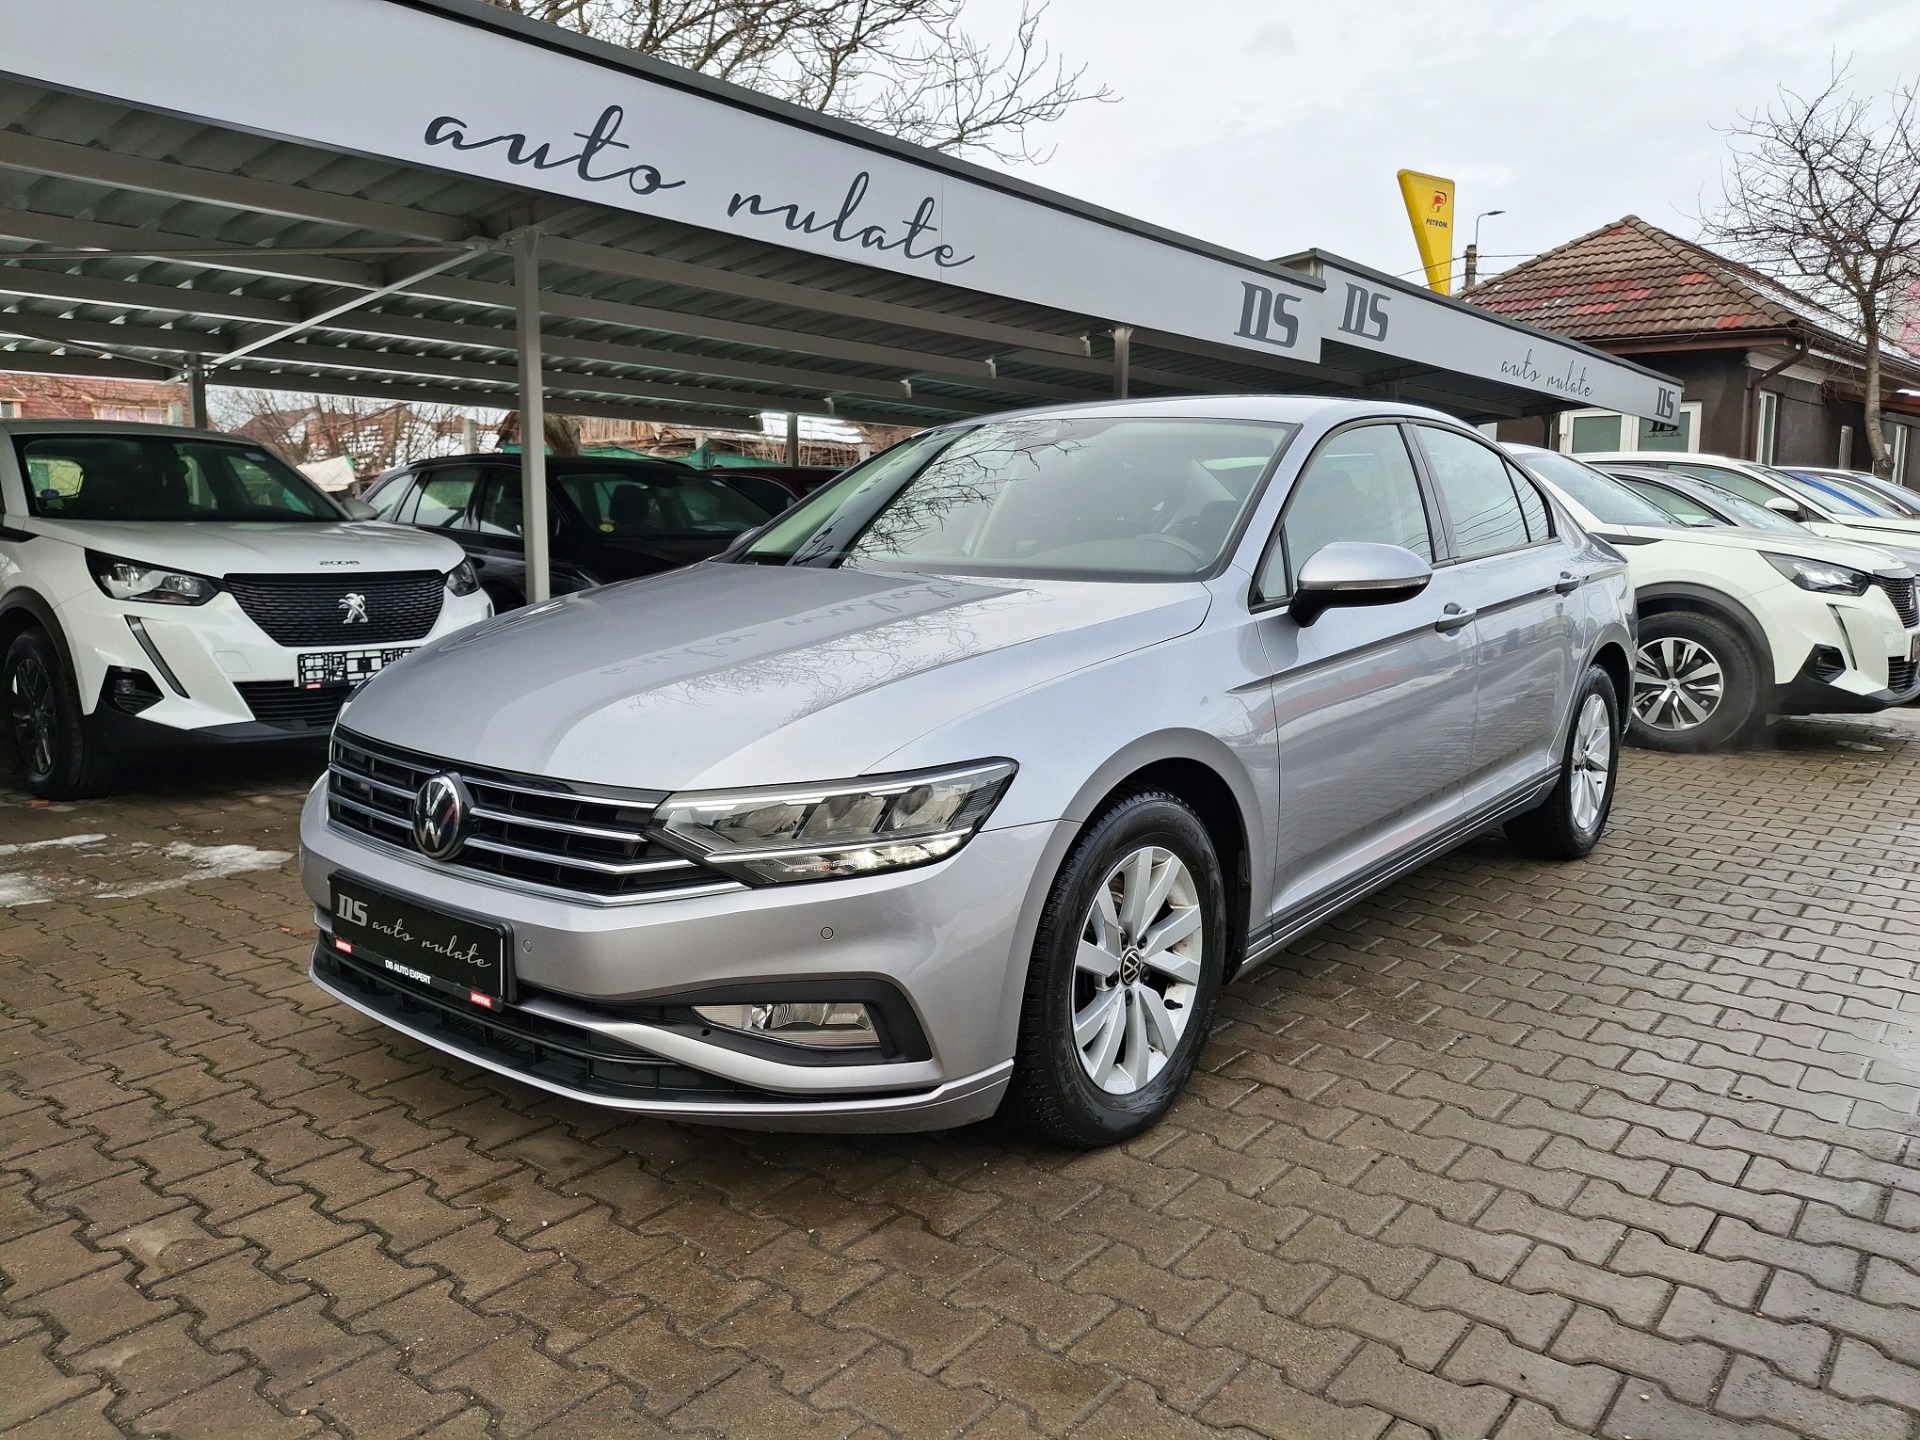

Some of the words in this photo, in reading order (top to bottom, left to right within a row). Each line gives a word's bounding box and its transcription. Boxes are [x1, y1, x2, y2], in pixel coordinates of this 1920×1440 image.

[424, 104, 686, 195] auto
[1425, 217, 1449, 229] PETROM
[1233, 280, 1302, 349] DS
[1338, 281, 1392, 342] DS
[1500, 348, 1541, 382] auto
[1654, 386, 1676, 420] DS
[336, 893, 369, 928] DS
[372, 918, 415, 942] auto
[393, 962, 409, 976] AUTO
[409, 968, 432, 985] EXPERT
